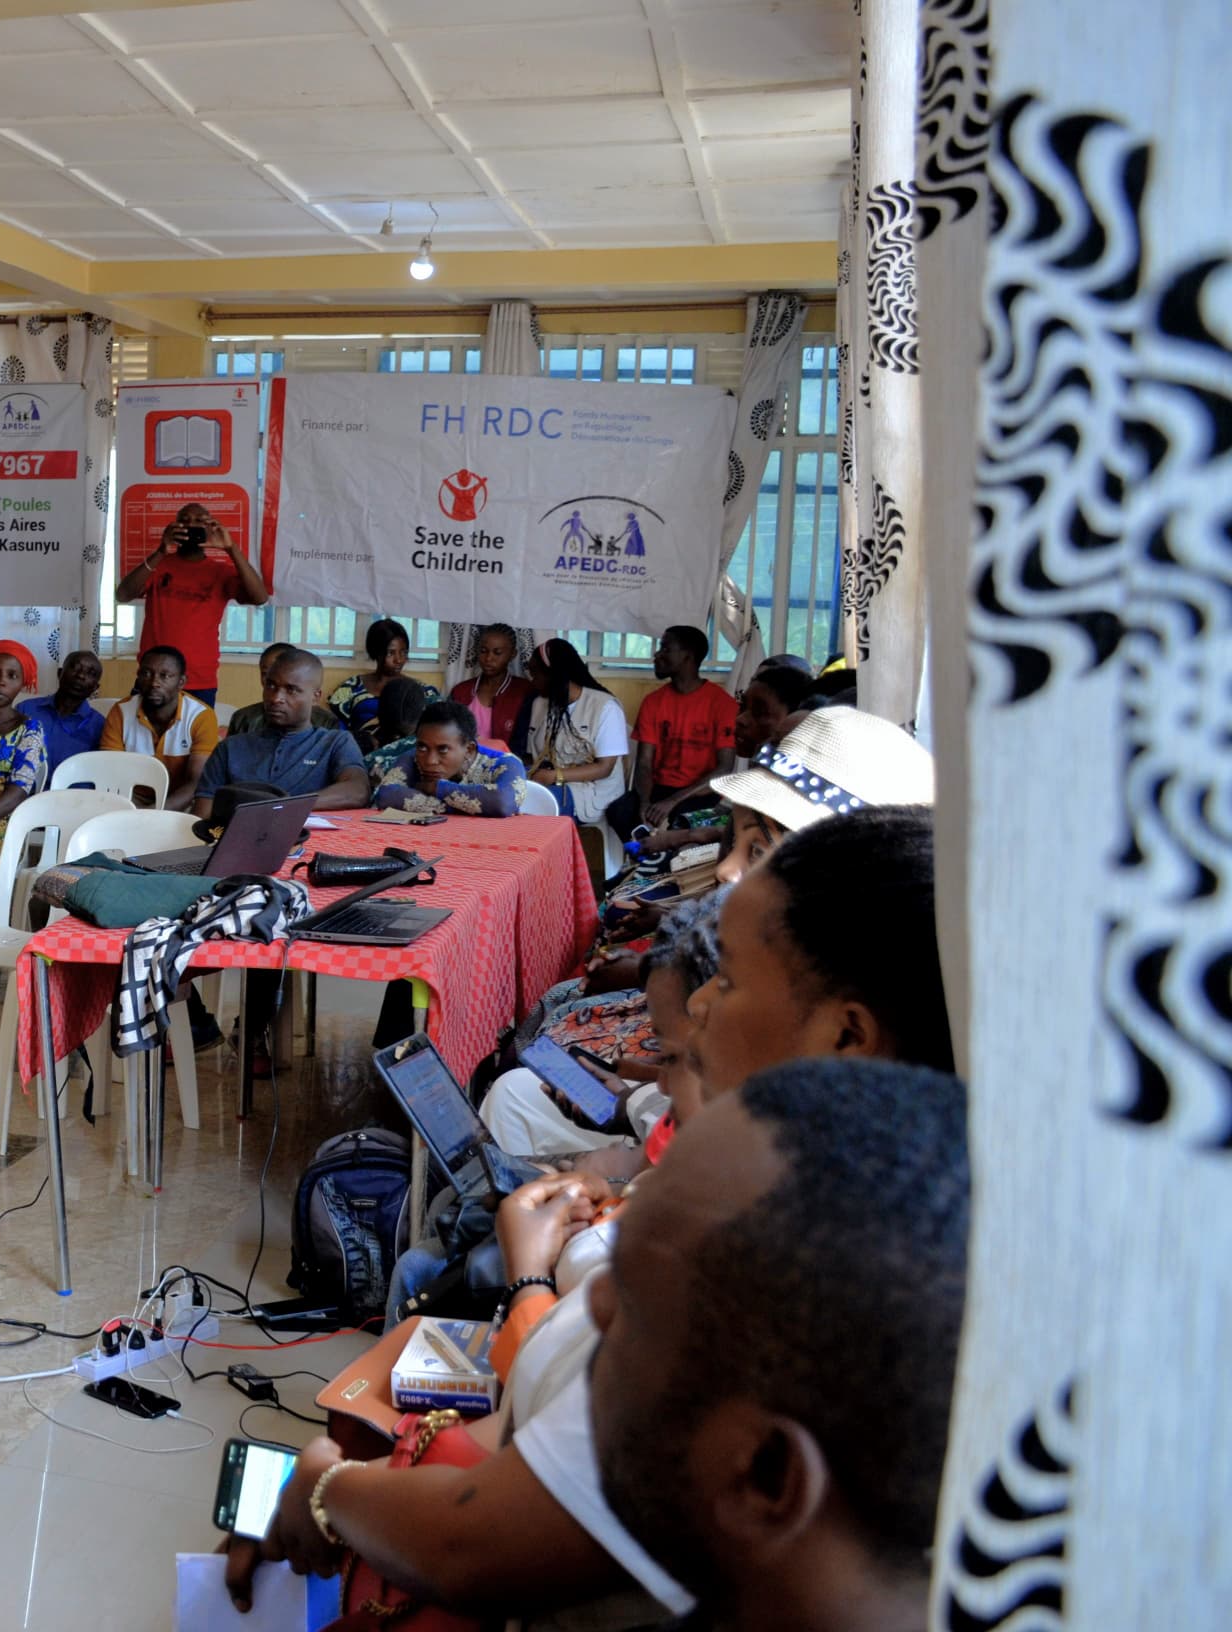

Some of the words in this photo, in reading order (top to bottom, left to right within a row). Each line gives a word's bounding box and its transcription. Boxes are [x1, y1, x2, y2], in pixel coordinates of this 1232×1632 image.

[301, 419, 344, 431] Financé
[420, 404, 466, 435] FH
[483, 405, 564, 439] RDC
[9, 517, 46, 532] Aires
[0, 537, 60, 555] Kasunyu
[414, 526, 464, 547] Save
[470, 529, 505, 550] the
[290, 547, 354, 561] Implémenté
[411, 550, 504, 575] Children
[554, 555, 647, 576] APEDC-RDC
